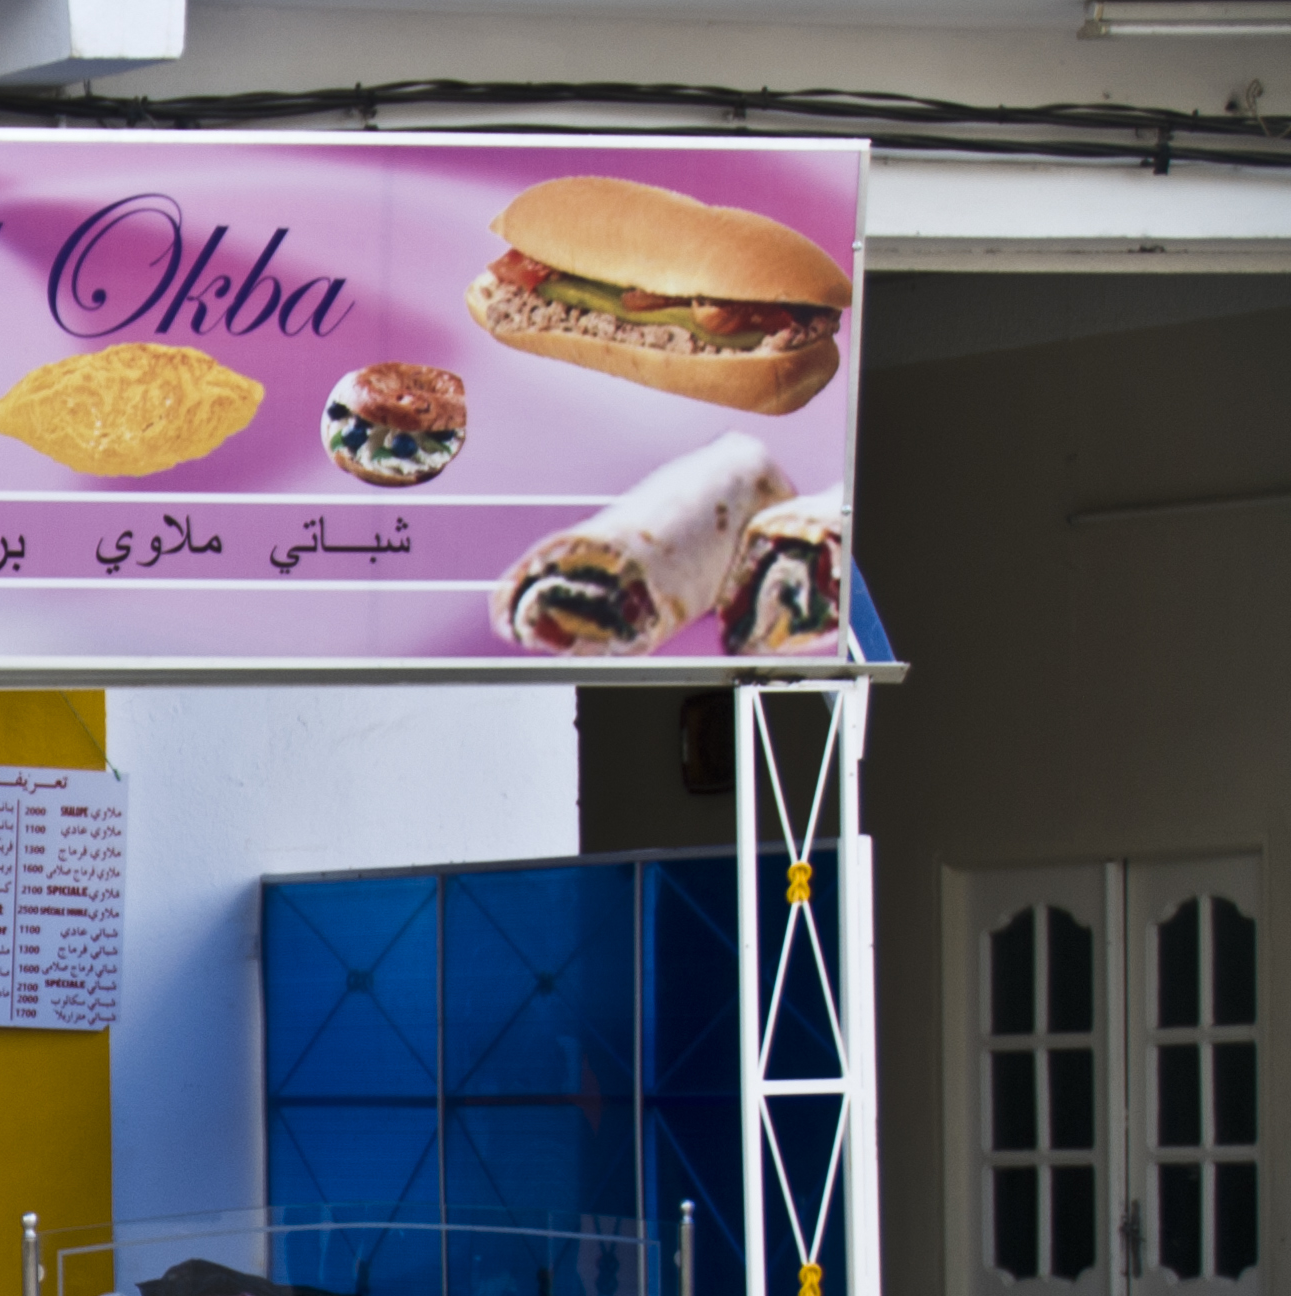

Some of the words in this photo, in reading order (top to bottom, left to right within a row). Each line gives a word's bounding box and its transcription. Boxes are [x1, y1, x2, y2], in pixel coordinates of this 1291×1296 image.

[48, 193, 355, 338] Okba
[95, 514, 223, 575] ملاوي
[269, 516, 411, 574] شباتي
[24, 806, 46, 816] 2000
[25, 825, 46, 834] 1100
[24, 845, 45, 854] 1300
[22, 864, 43, 873] 1600
[21, 885, 43, 895] 2100
[20, 925, 41, 934] 1100
[19, 945, 40, 954] 1300
[19, 964, 40, 973] 1600
[17, 983, 38, 992] 2100
[17, 994, 38, 1004] 2000
[16, 1008, 37, 1018] 1700
